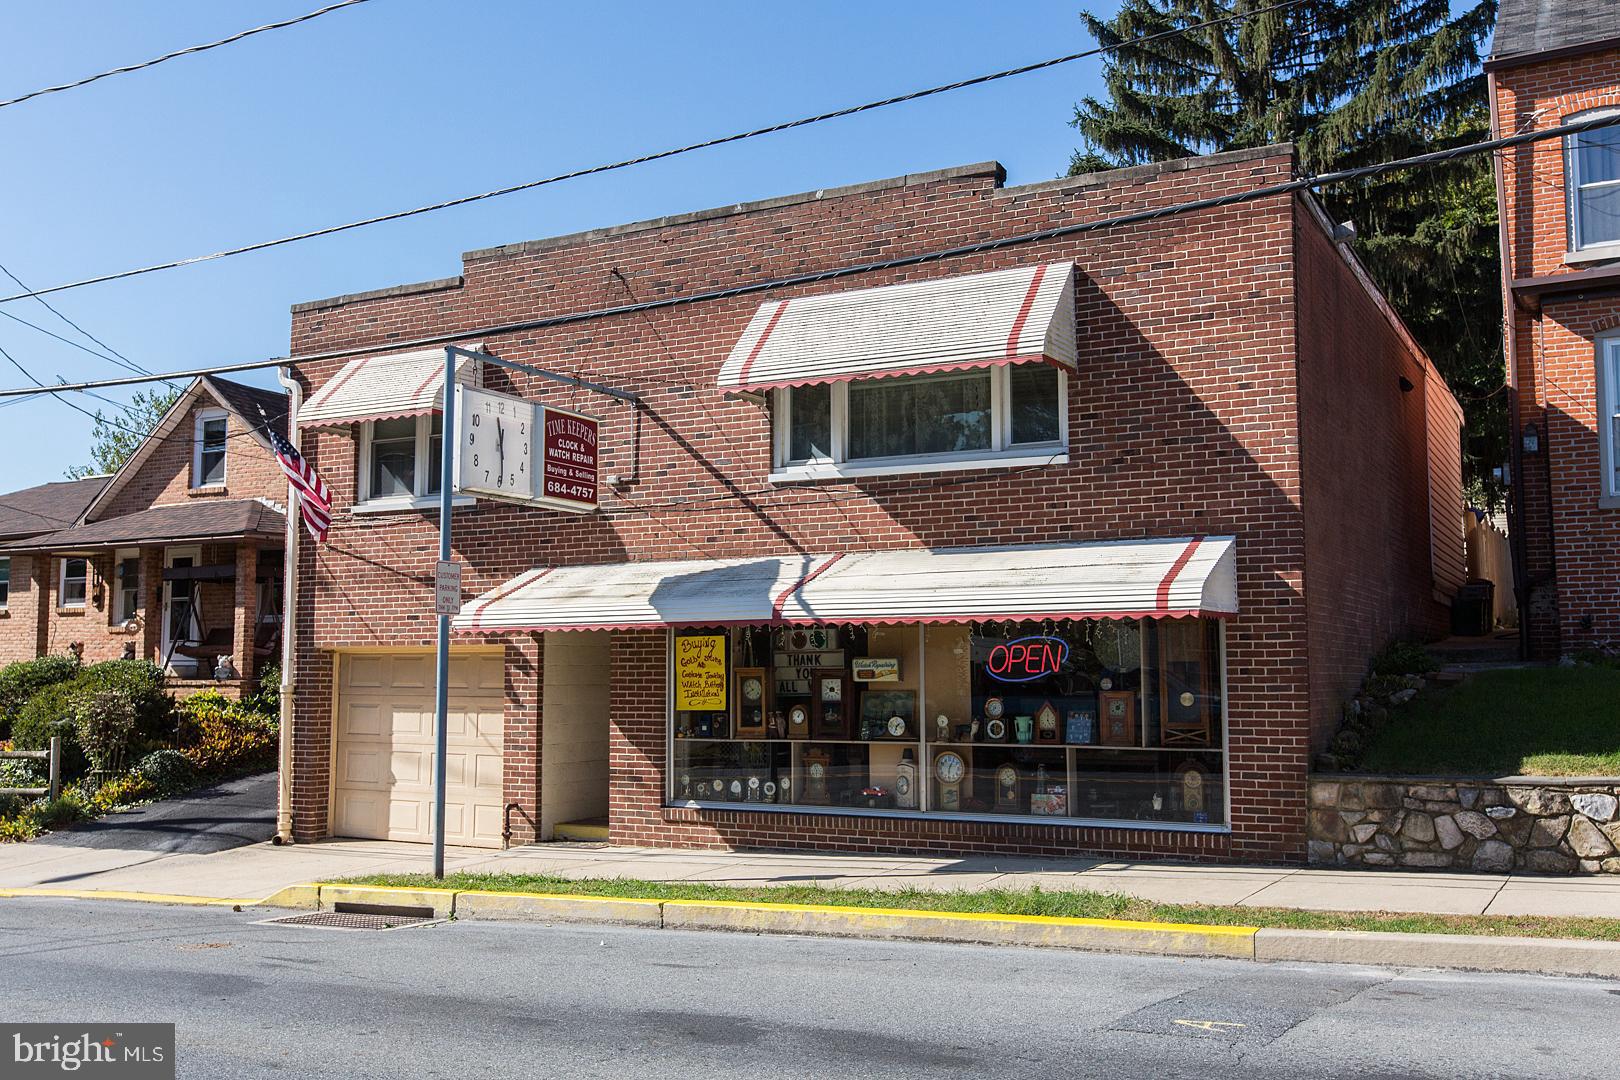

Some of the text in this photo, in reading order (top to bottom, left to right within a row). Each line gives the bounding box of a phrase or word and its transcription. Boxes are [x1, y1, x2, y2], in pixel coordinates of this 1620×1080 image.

[485, 402, 491, 414] 11
[498, 402, 505, 414] 12
[472, 413, 480, 427] 10
[520, 422, 525, 435] 2
[547, 418, 597, 447] TIME KEEPERS
[469, 433, 475, 446] 9
[558, 438, 585, 452] CLOCK &
[523, 443, 528, 455] 3
[473, 454, 479, 467] 8
[548, 447, 594, 465] WATCH REPAIR
[519, 462, 524, 474] 4
[547, 464, 595, 482] Buying & Selling
[484, 470, 490, 483] 7
[510, 474, 514, 486] 5
[547, 481, 594, 499] 684-4757
[439, 584, 458, 592] PARKING
[442, 596, 453, 604] ONLY
[787, 654, 822, 666] THANK
[988, 644, 1062, 673] OPEN
[796, 668, 812, 679] YO
[780, 681, 798, 692] ALL
